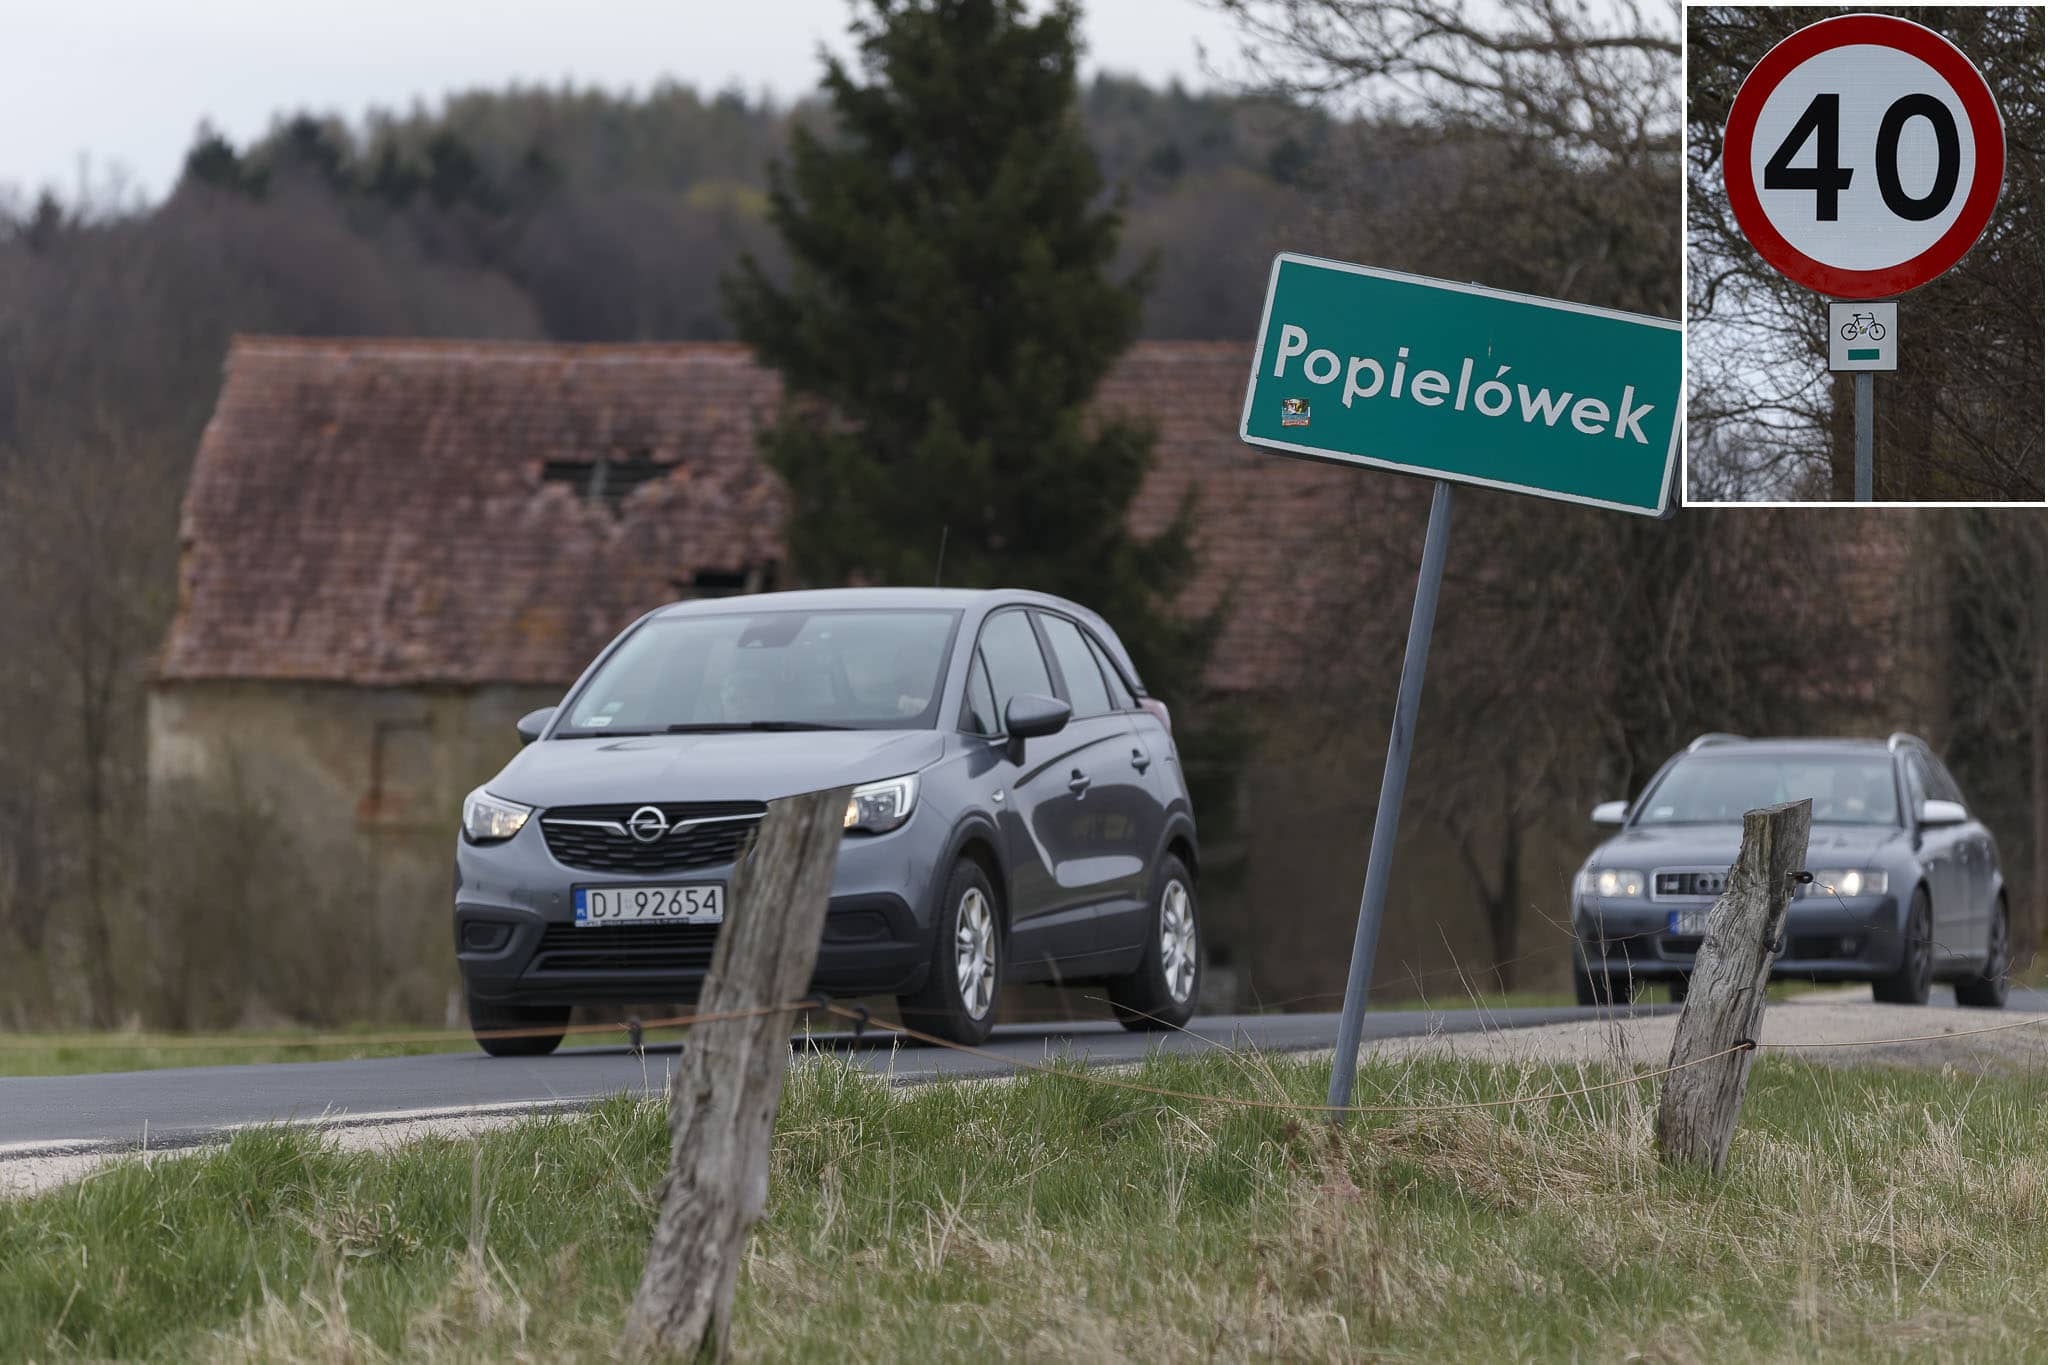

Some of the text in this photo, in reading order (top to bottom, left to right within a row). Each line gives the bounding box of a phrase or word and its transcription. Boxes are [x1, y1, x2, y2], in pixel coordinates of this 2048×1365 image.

[1764, 93, 1960, 221] 40
[1273, 323, 1655, 445] Popielówek
[592, 889, 717, 918] DJ 92654
